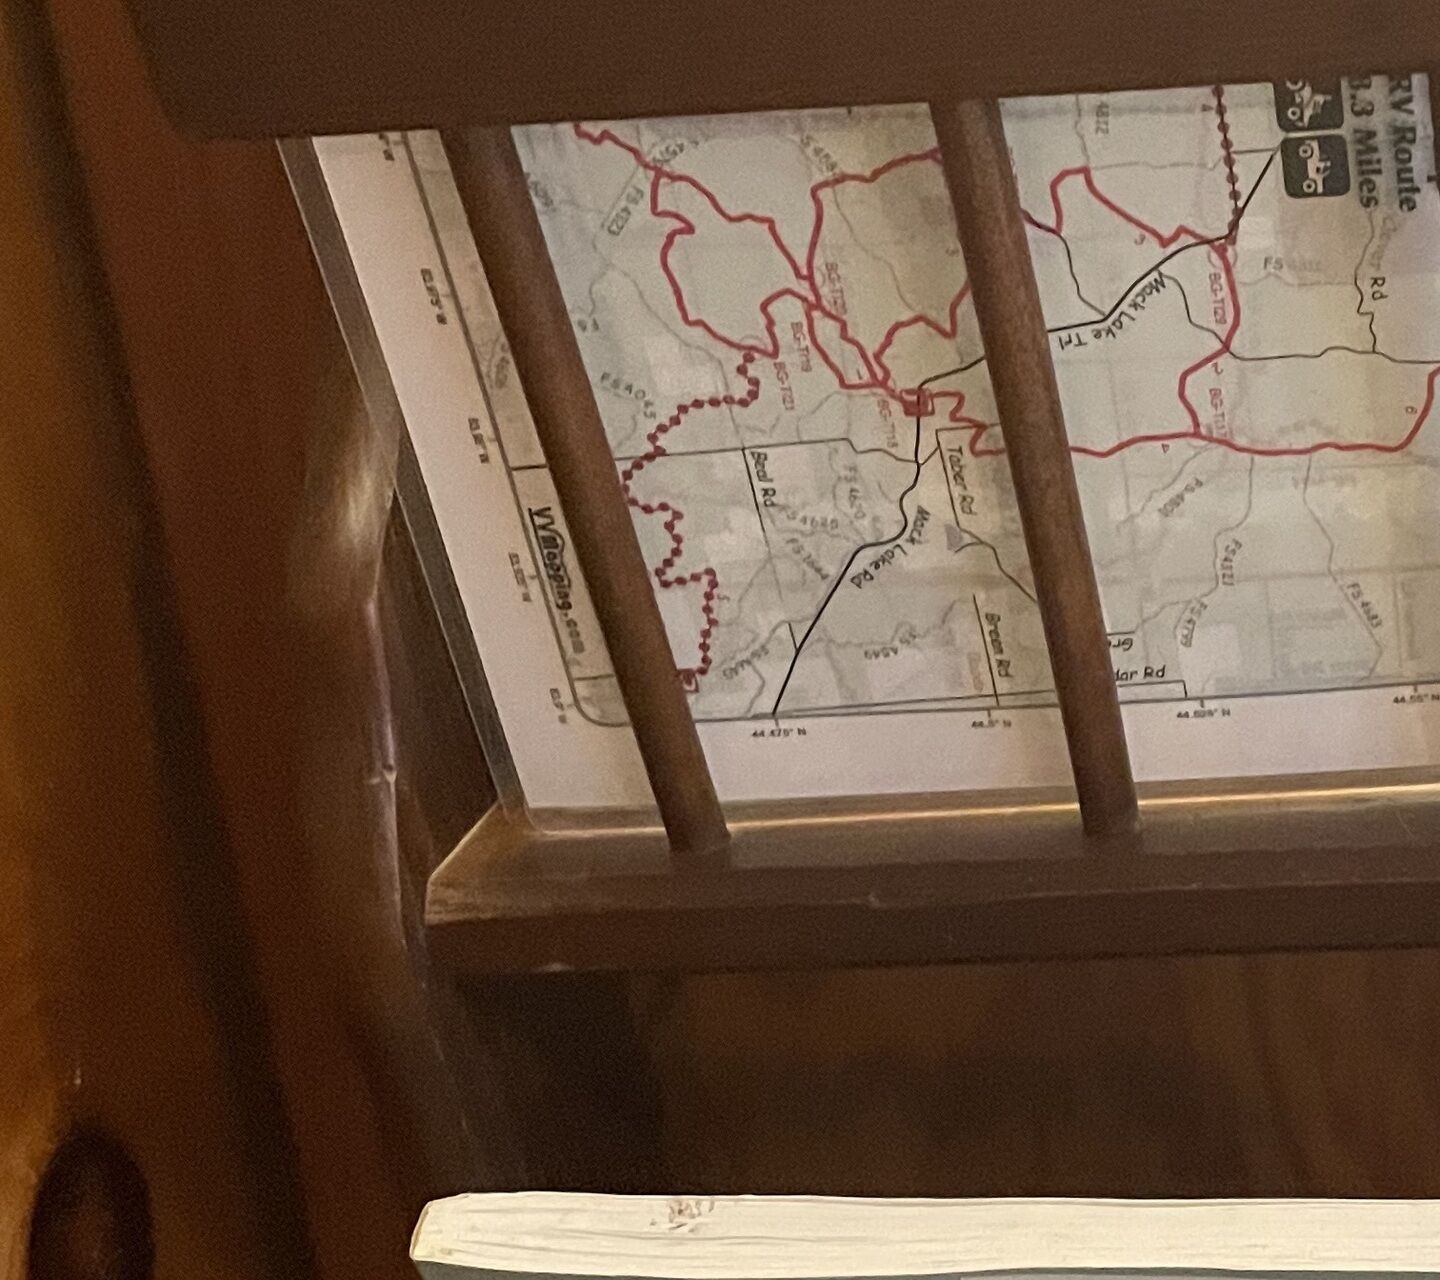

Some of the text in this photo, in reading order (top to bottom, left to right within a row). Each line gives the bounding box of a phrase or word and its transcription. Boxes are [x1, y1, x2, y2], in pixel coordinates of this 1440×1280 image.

[1353, 128, 1380, 211] Miles
[1390, 122, 1420, 213] Route
[1128, 269, 1168, 310] Mack
[1368, 276, 1387, 301] Rd
[1091, 306, 1136, 340] Lake
[760, 487, 778, 509] Rd
[956, 495, 978, 518] Rd
[870, 542, 910, 574] Lake
[849, 565, 876, 591] Rd
[994, 655, 1016, 680] Rd
[1144, 664, 1167, 680] Rd
